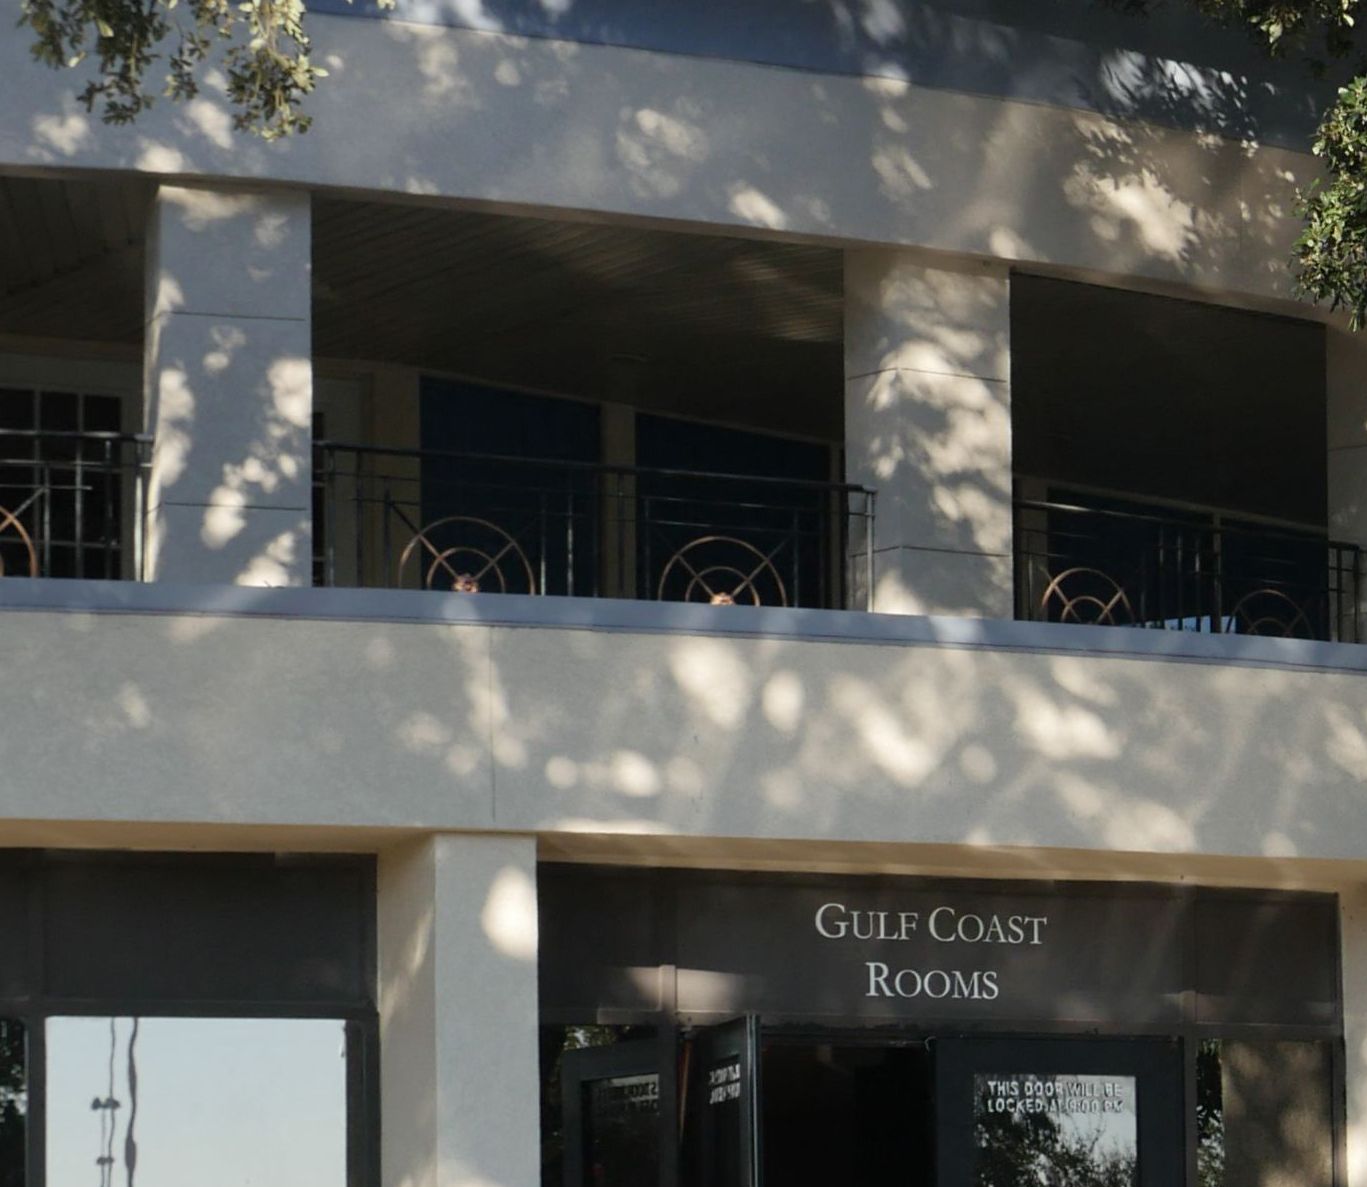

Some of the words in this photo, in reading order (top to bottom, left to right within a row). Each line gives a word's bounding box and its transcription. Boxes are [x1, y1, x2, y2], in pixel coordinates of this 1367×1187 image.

[814, 902, 919, 940] GULF
[928, 906, 1048, 945] COAST
[865, 961, 999, 1000] ROOMS
[987, 1081, 1019, 1096] THIS
[1024, 1081, 1063, 1097] DOOR
[1066, 1081, 1099, 1097] WILL
[987, 1098, 1043, 1113] LOCKED
